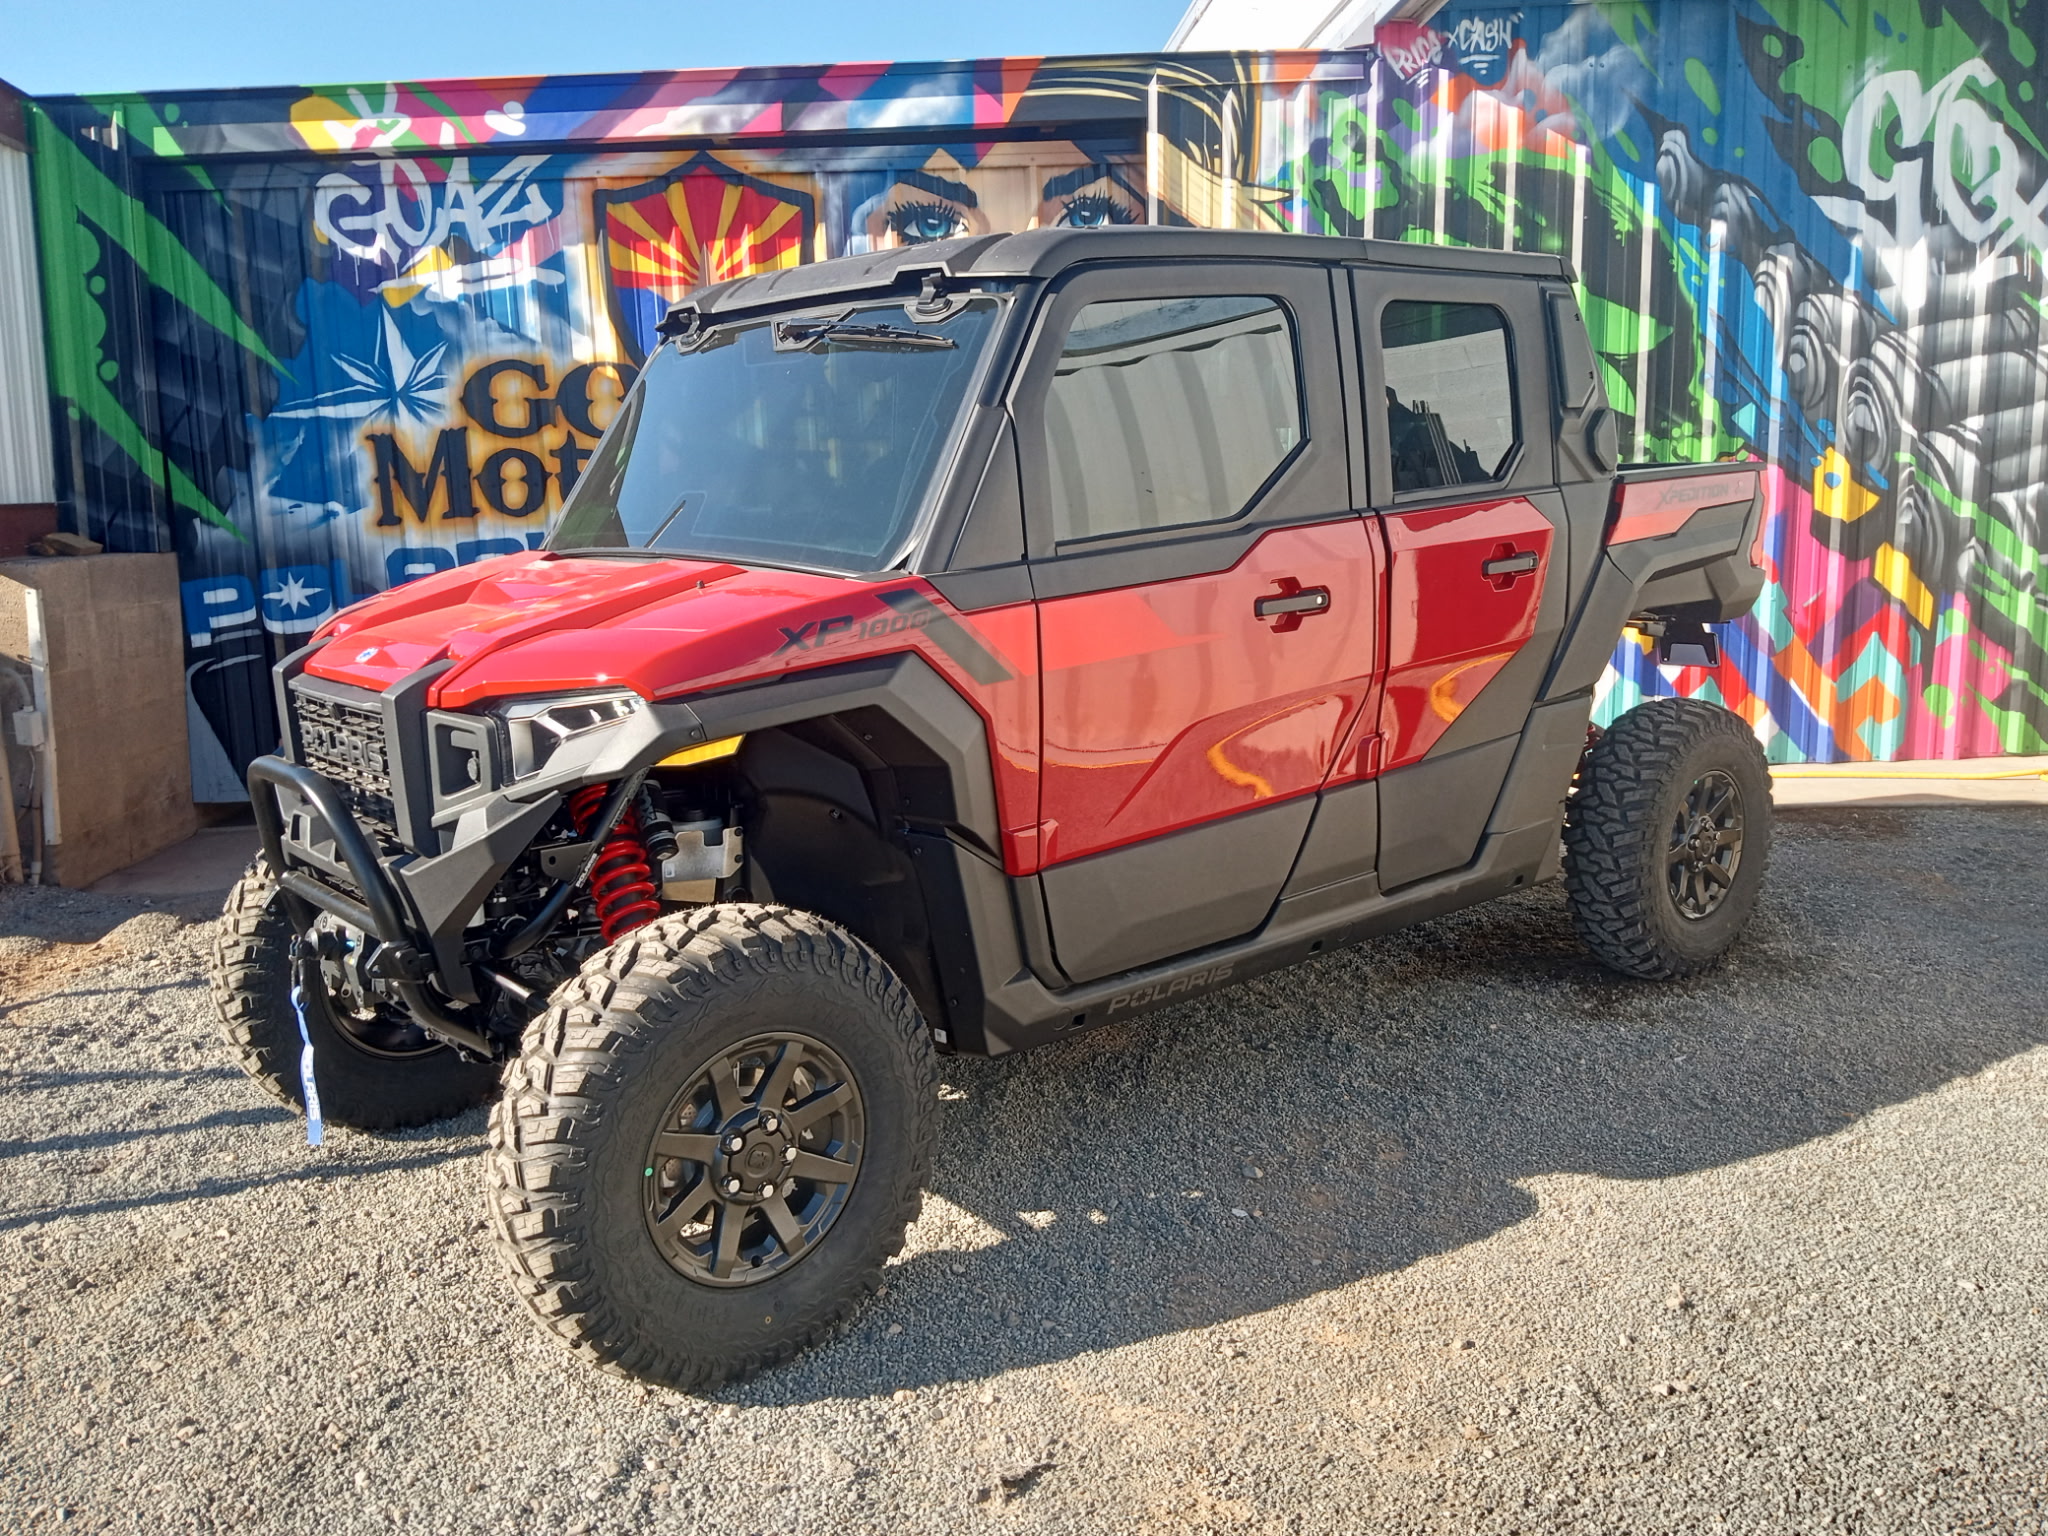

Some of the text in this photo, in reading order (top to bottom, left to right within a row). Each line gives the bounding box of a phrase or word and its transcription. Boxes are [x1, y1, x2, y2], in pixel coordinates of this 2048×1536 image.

[770, 614, 854, 658] XP
[301, 721, 384, 773] POLARIS
[1106, 961, 1235, 1015] POLARIS
